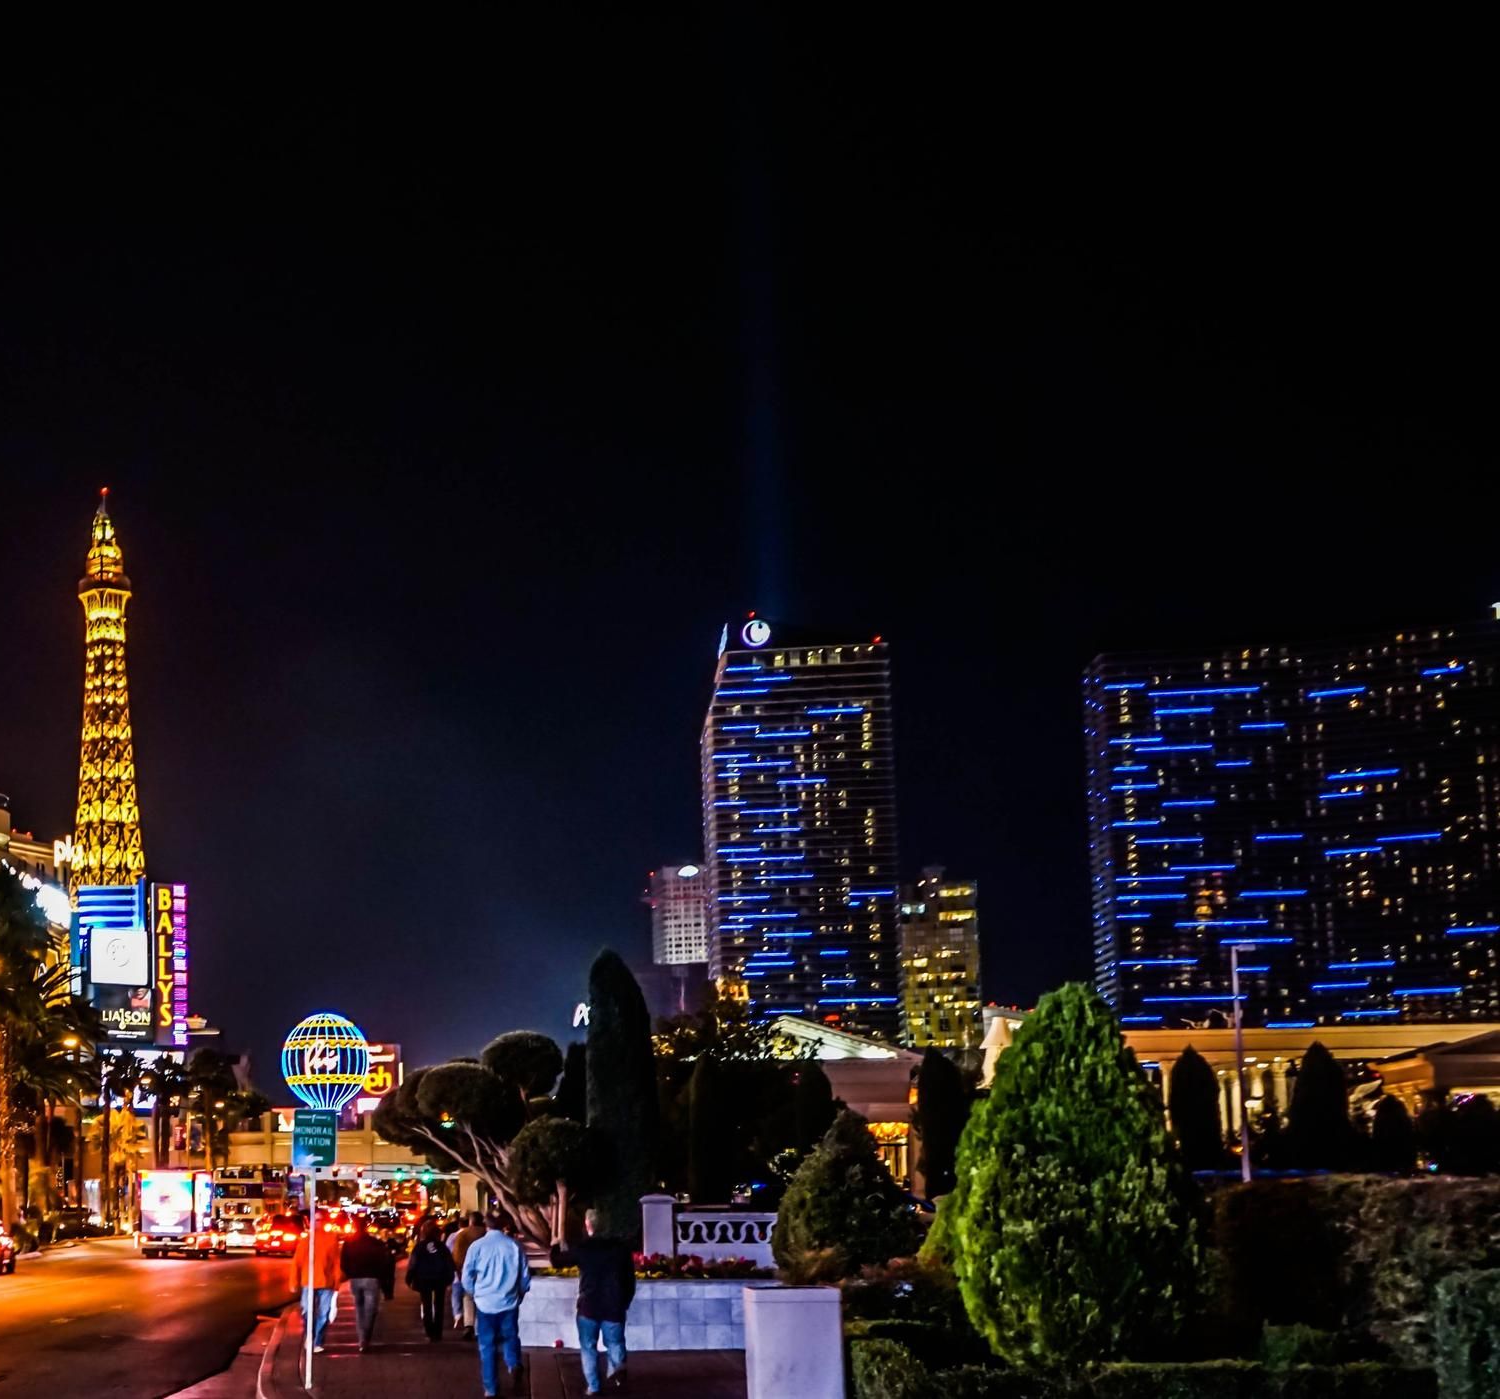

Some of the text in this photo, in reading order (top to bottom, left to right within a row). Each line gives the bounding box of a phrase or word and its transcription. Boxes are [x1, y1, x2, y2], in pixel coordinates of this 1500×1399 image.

[156, 888, 174, 1027] BALLYS
[102, 1008, 151, 1030] LIAISON
[294, 1126, 333, 1135] MONORAIL
[299, 1137, 331, 1146] STATION
